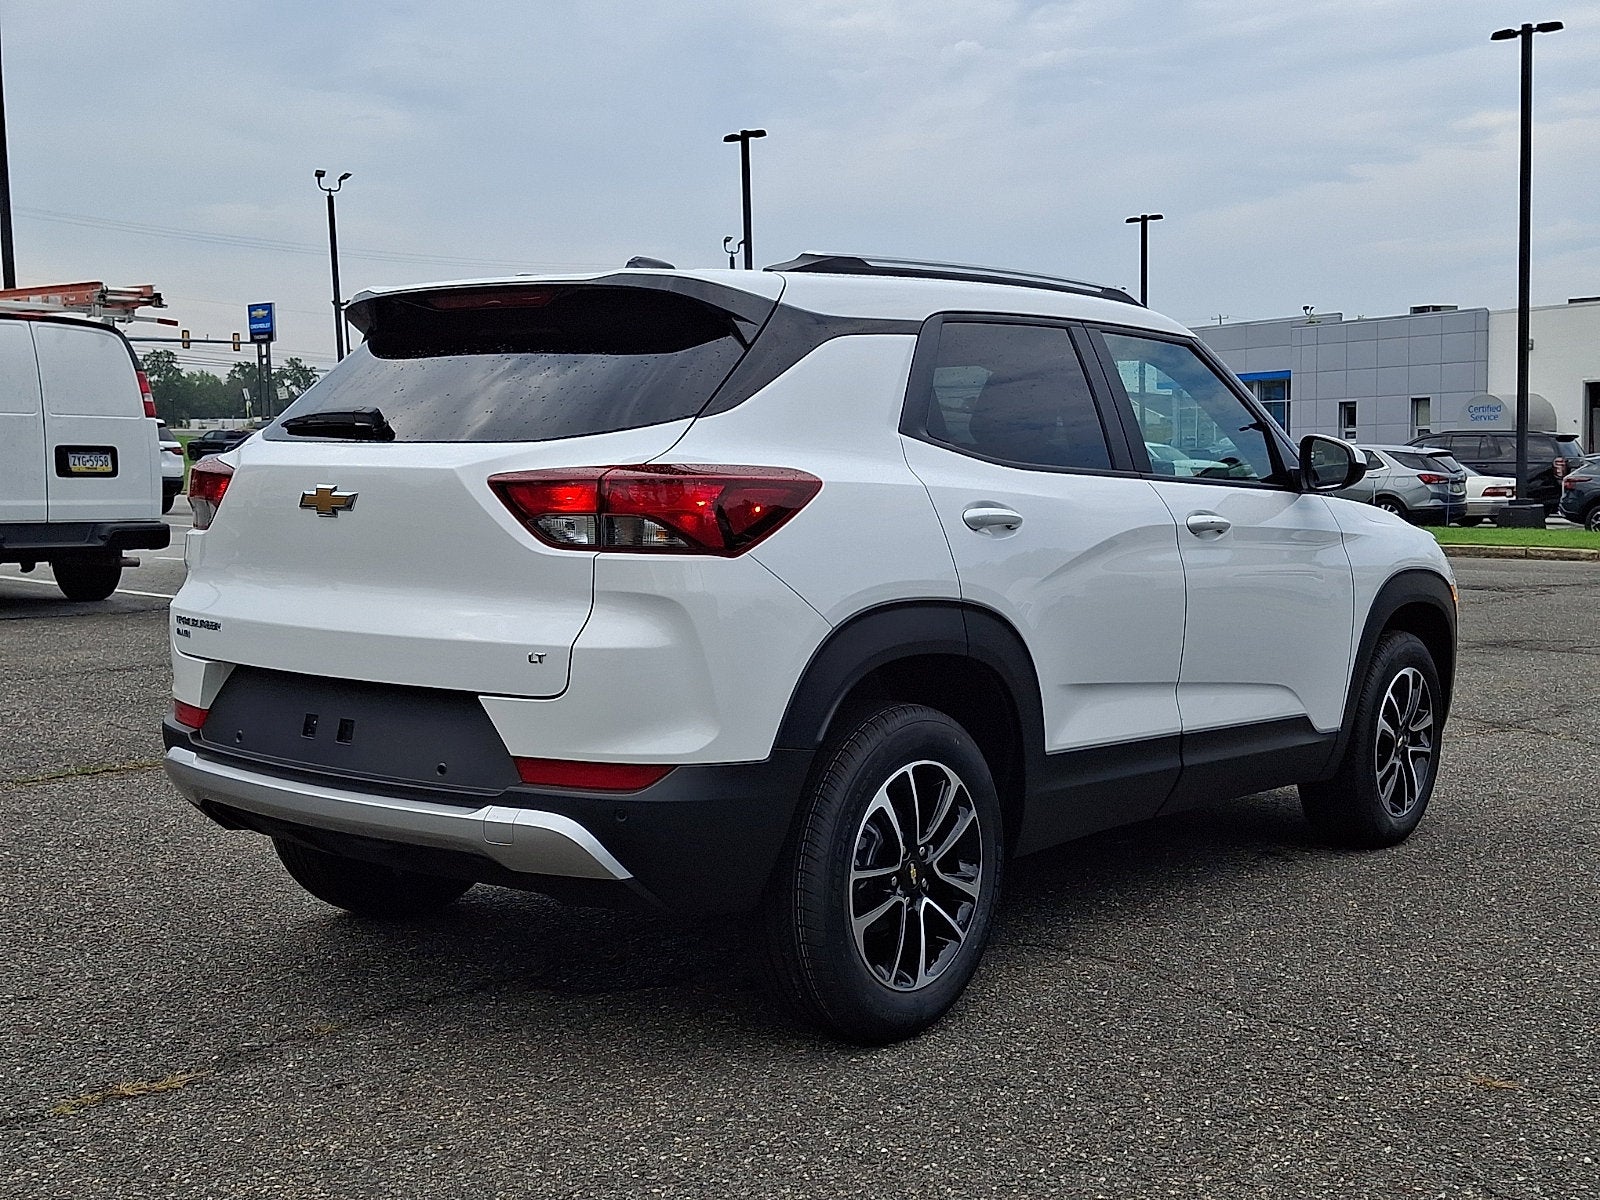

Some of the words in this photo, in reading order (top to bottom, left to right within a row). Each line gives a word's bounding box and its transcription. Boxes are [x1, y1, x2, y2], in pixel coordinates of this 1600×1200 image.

[1467, 404, 1502, 413] Certified
[1470, 413, 1499, 421] Service
[527, 652, 547, 664] LT
